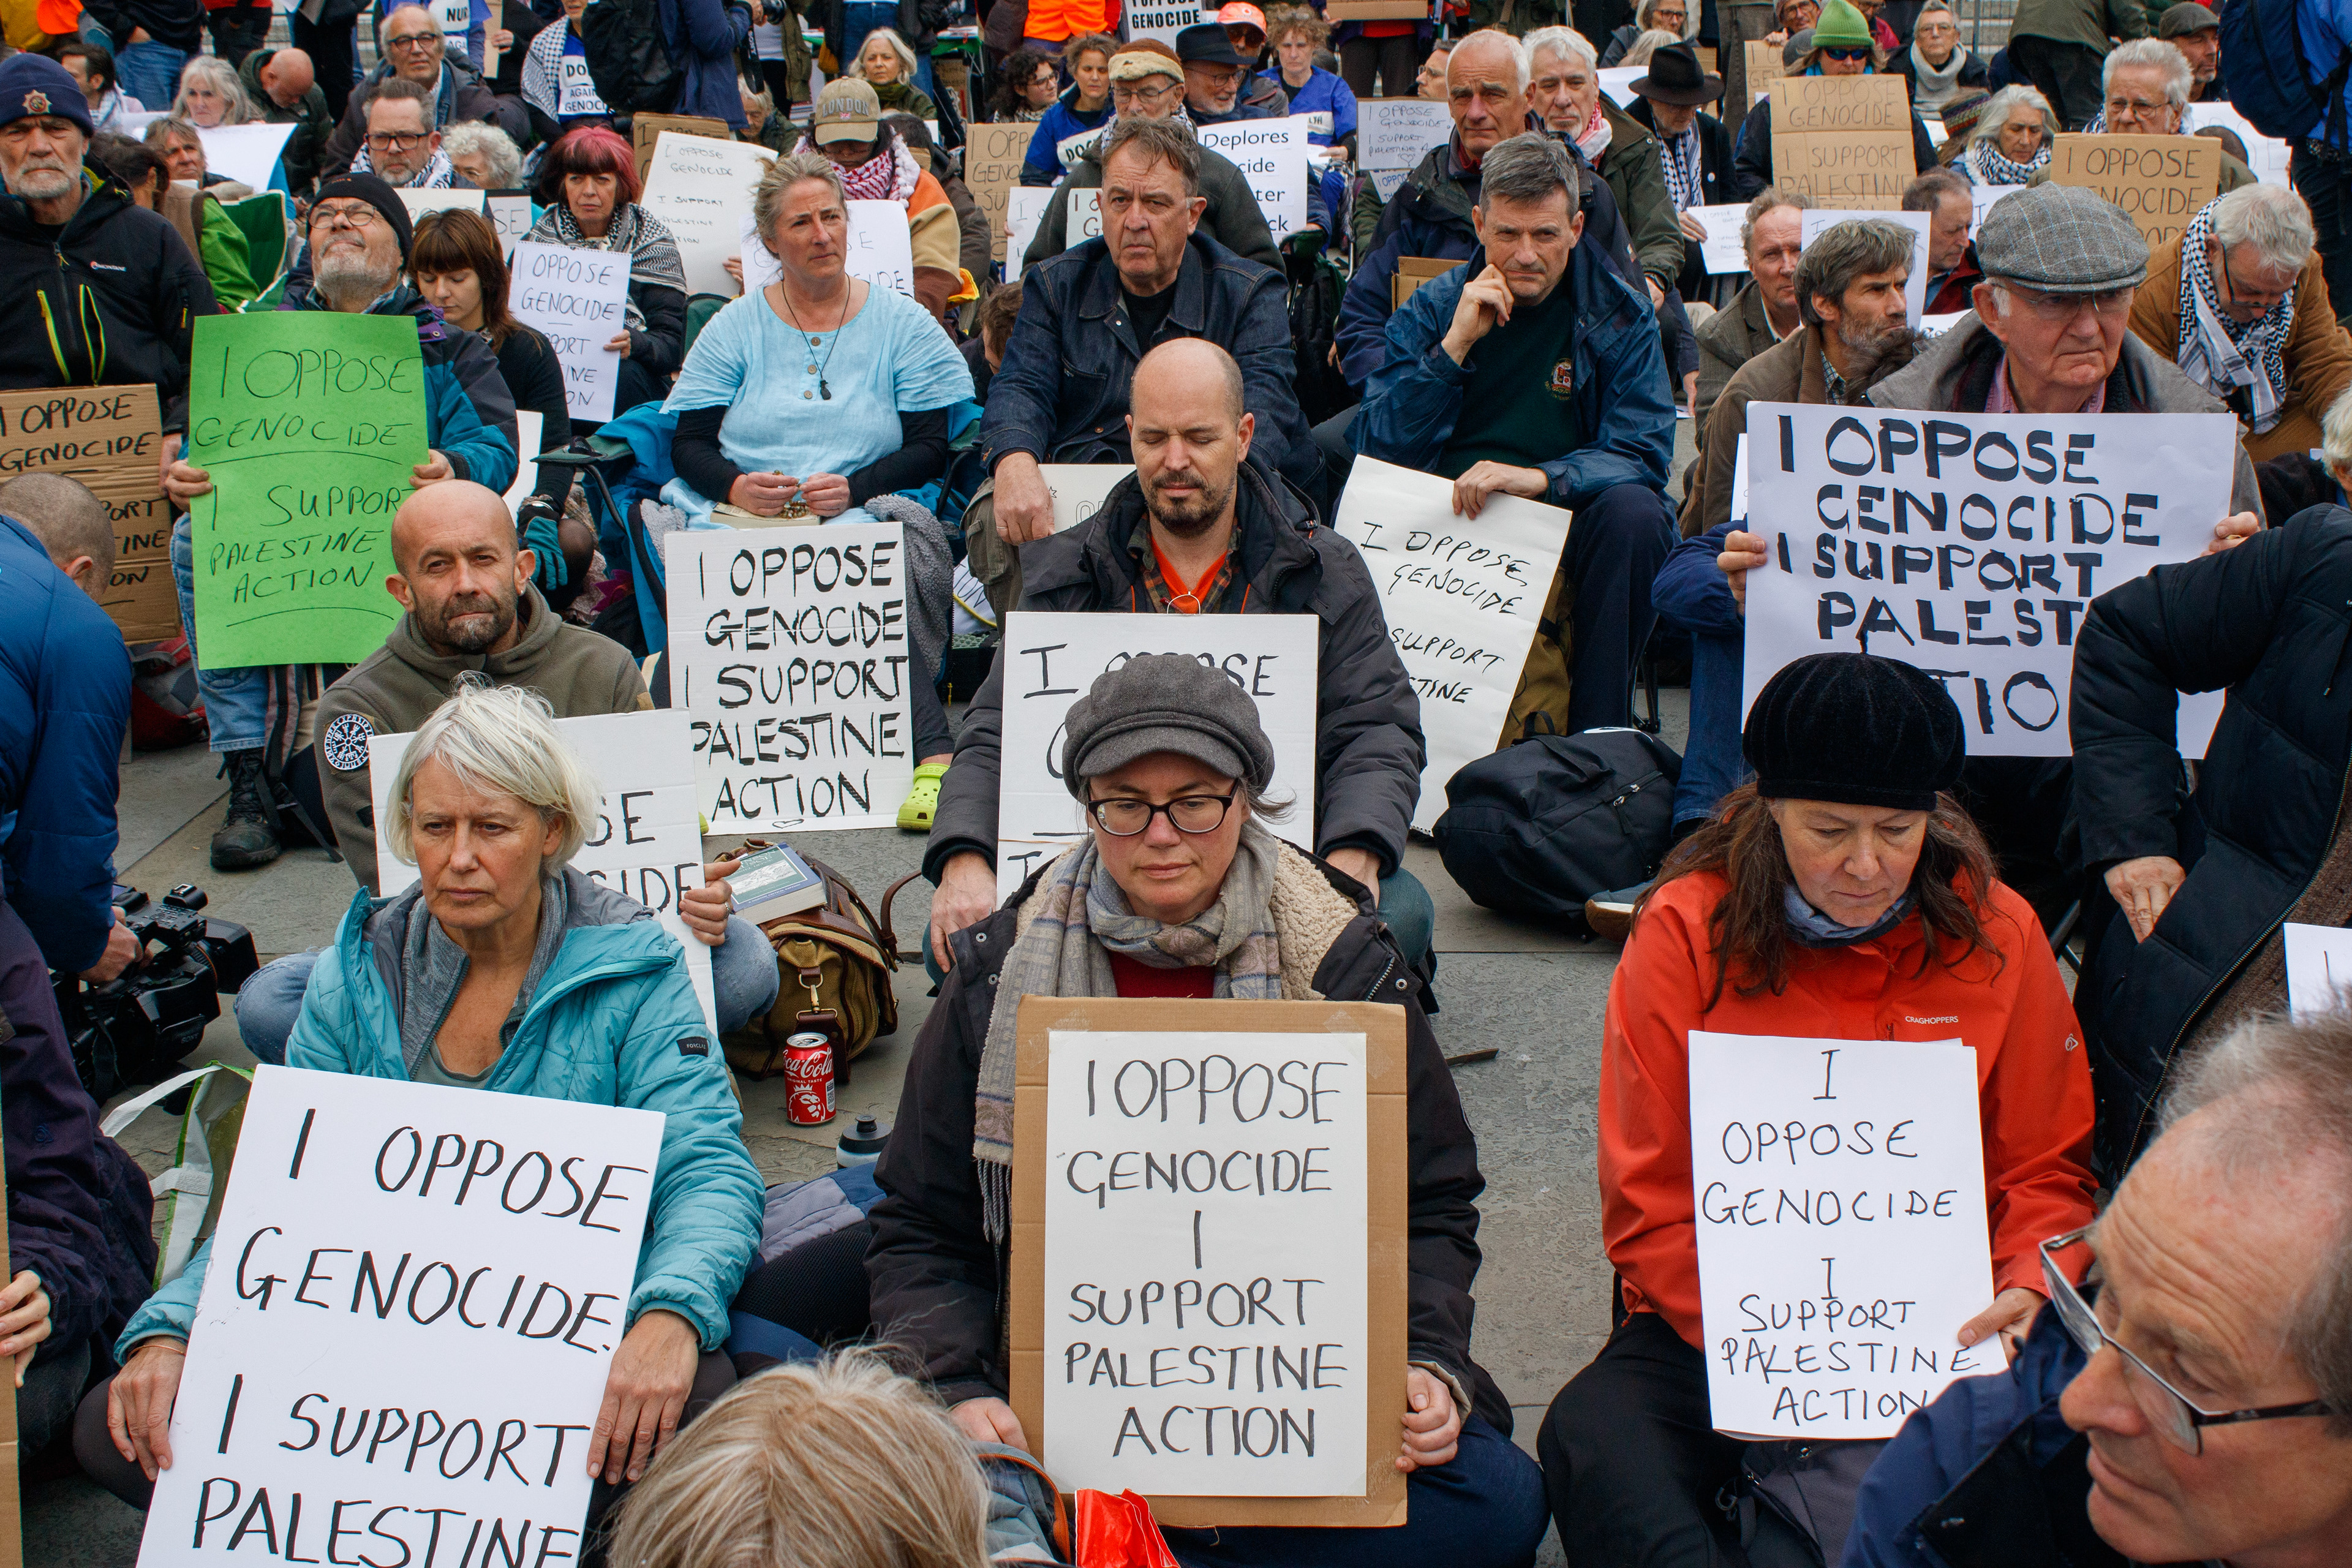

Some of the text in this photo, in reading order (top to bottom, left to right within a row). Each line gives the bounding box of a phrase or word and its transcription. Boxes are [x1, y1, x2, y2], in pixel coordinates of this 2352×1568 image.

[1132, 9, 1200, 29] GENOCIDE
[1751, 45, 1755, 64] I
[823, 97, 869, 118] LONDON
[1368, 105, 1436, 121] I OPPOSE
[1783, 83, 1787, 107] I
[1804, 78, 1898, 105] OPPOSE
[1790, 103, 1895, 127] GENOCIDE
[679, 147, 723, 159] OPPOSE
[971, 130, 975, 160] I
[988, 130, 1031, 158] OPP
[1204, 130, 1289, 150] Deplores
[1368, 134, 1425, 145] I SUPPORT
[1785, 145, 1903, 171] I SUPPORT
[670, 163, 734, 176] GENOCIDE
[2067, 146, 2203, 178] I OPPOSE
[674, 196, 724, 208] SUPPORT
[1074, 194, 1079, 212] I
[2090, 186, 2203, 214] NOCIDE
[519, 252, 614, 285] I OPPOSE
[522, 287, 618, 320] GENOCIDE
[222, 347, 423, 398] I OPPOSE
[0, 393, 138, 437] I OPPOSE
[195, 412, 412, 447] GENOCIDE
[0, 432, 158, 472] GENOCIDE
[1778, 415, 2098, 484] I OPPOSE
[211, 485, 218, 530] I
[209, 527, 384, 577] PALESTINE
[699, 541, 899, 601] I OPPOSE
[1360, 522, 1530, 586] I OPPOSE
[1778, 532, 2103, 598] I SUPPORT
[234, 561, 374, 603] ACTION
[1388, 564, 1522, 615] GENOCIDE
[705, 600, 903, 652] GENOCIDE
[1020, 644, 1079, 698] I
[1389, 628, 1504, 673] SUPPORT
[685, 656, 908, 709] I SUPPORT
[690, 712, 905, 768] PALESTINE
[712, 769, 870, 822] ACTION
[1905, 1016, 1958, 1025] CRAGHOPPERS
[1087, 1054, 1349, 1125] I OPPOSE
[1813, 1049, 1841, 1100] I
[1722, 1120, 1918, 1165] OPPOSE
[289, 1109, 649, 1232] I OPPOSE
[1066, 1147, 1333, 1209] GENOCIDE
[1702, 1182, 1958, 1226] GENOCIDE
[1194, 1210, 1202, 1270] I
[1821, 1257, 1839, 1300] I
[1068, 1276, 1325, 1329] SUPPORT
[1738, 1294, 1916, 1333] SUPPORT
[1065, 1341, 1349, 1392] PALESTINE
[1721, 1337, 1981, 1384] PALESTINE
[1772, 1386, 1928, 1427] ACTION
[218, 1374, 591, 1487] I SUPPORT
[1112, 1405, 1315, 1458] ACTION
[193, 1477, 580, 1568] PALESTINE
